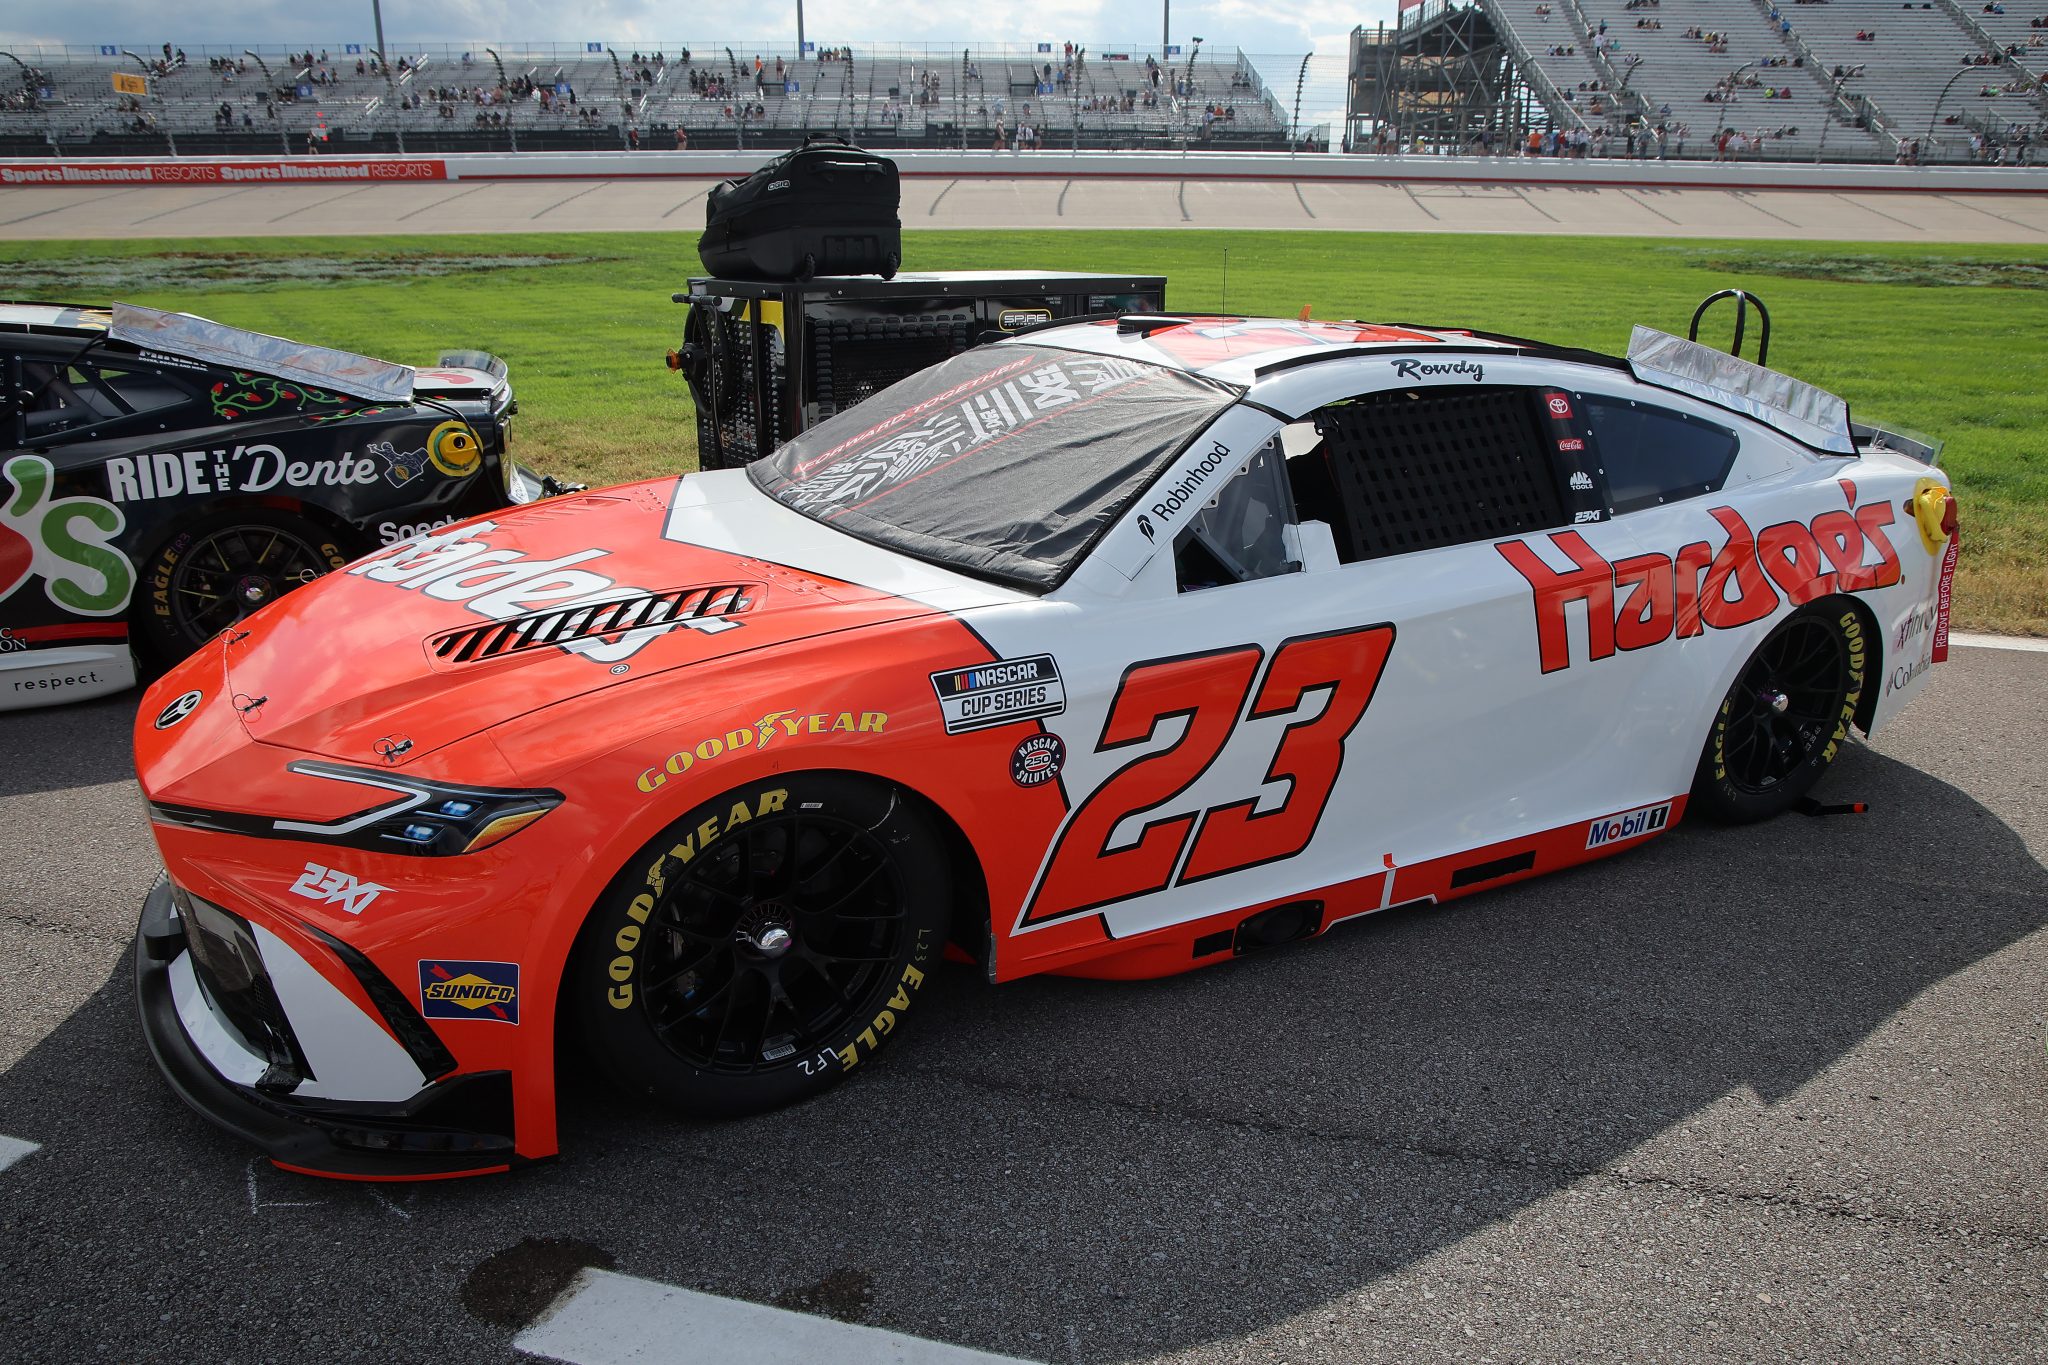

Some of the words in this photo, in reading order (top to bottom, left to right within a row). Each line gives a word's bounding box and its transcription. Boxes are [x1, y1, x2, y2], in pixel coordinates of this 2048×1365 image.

[1, 167, 62, 182] Sports
[62, 166, 153, 181] Illustrated
[154, 166, 216, 181] RESORTS
[219, 165, 280, 180] Sports
[281, 164, 369, 179] Illustrated
[371, 163, 432, 177] RESORTS
[1004, 313, 1046, 323] SPIRE
[1391, 358, 1485, 382] Rowdy
[801, 413, 906, 470] FORWARD
[912, 358, 1027, 414] TOGETHER
[106, 451, 210, 503] RIDE
[213, 449, 231, 491] THE
[1151, 440, 1231, 522] Robinhood
[1569, 471, 1592, 486] MAC
[1570, 483, 1593, 491] TOOLS
[1943, 543, 1958, 573] FLIGHT
[154, 548, 182, 616] EAGLE
[1494, 478, 1902, 675] Hardee's
[1939, 575, 1952, 610] BEFORE
[1935, 611, 1948, 649] REMOVE
[14, 672, 104, 692] respect.
[975, 662, 1039, 688] NASCAR
[961, 695, 992, 717] CUP
[994, 686, 1047, 711] SERIES
[1018, 737, 1059, 758] NASCAR
[1025, 754, 1051, 767] 250
[1016, 762, 1059, 784] SALUTES
[1018, 620, 1397, 929] 23
[1588, 811, 1648, 845] Mobil
[288, 861, 399, 915] 23XI
[429, 983, 513, 1002] SUNOCO
[837, 963, 926, 1073] EAGLE
[797, 1047, 840, 1076] LF2
